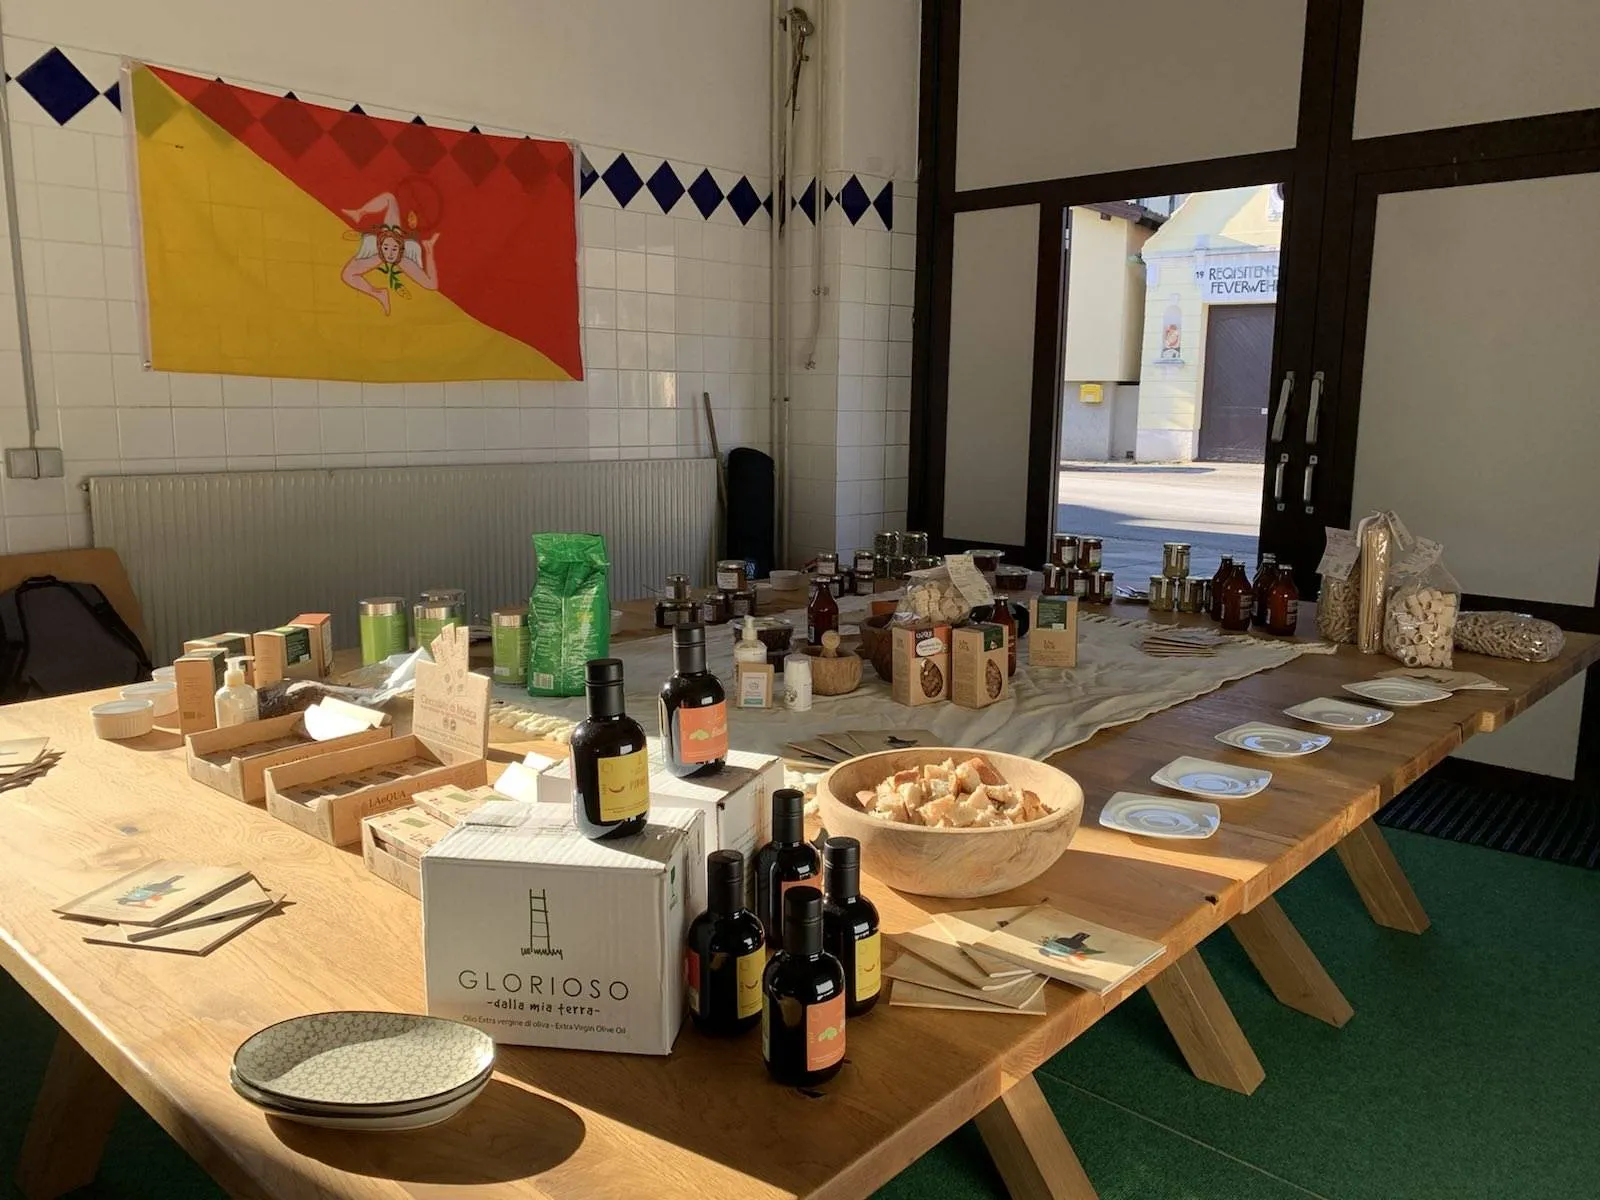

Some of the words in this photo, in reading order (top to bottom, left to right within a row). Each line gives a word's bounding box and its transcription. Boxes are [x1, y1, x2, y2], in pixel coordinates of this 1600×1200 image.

[458, 969, 629, 1001] GLORIOSO
[529, 1002, 553, 1013] mia
[478, 1016, 497, 1025] Extra
[533, 1021, 550, 1029] oliva
[555, 1022, 573, 1031] Extra
[573, 1023, 595, 1034] Virgin
[596, 1025, 615, 1033] Olive
[615, 1026, 627, 1034] Oil
